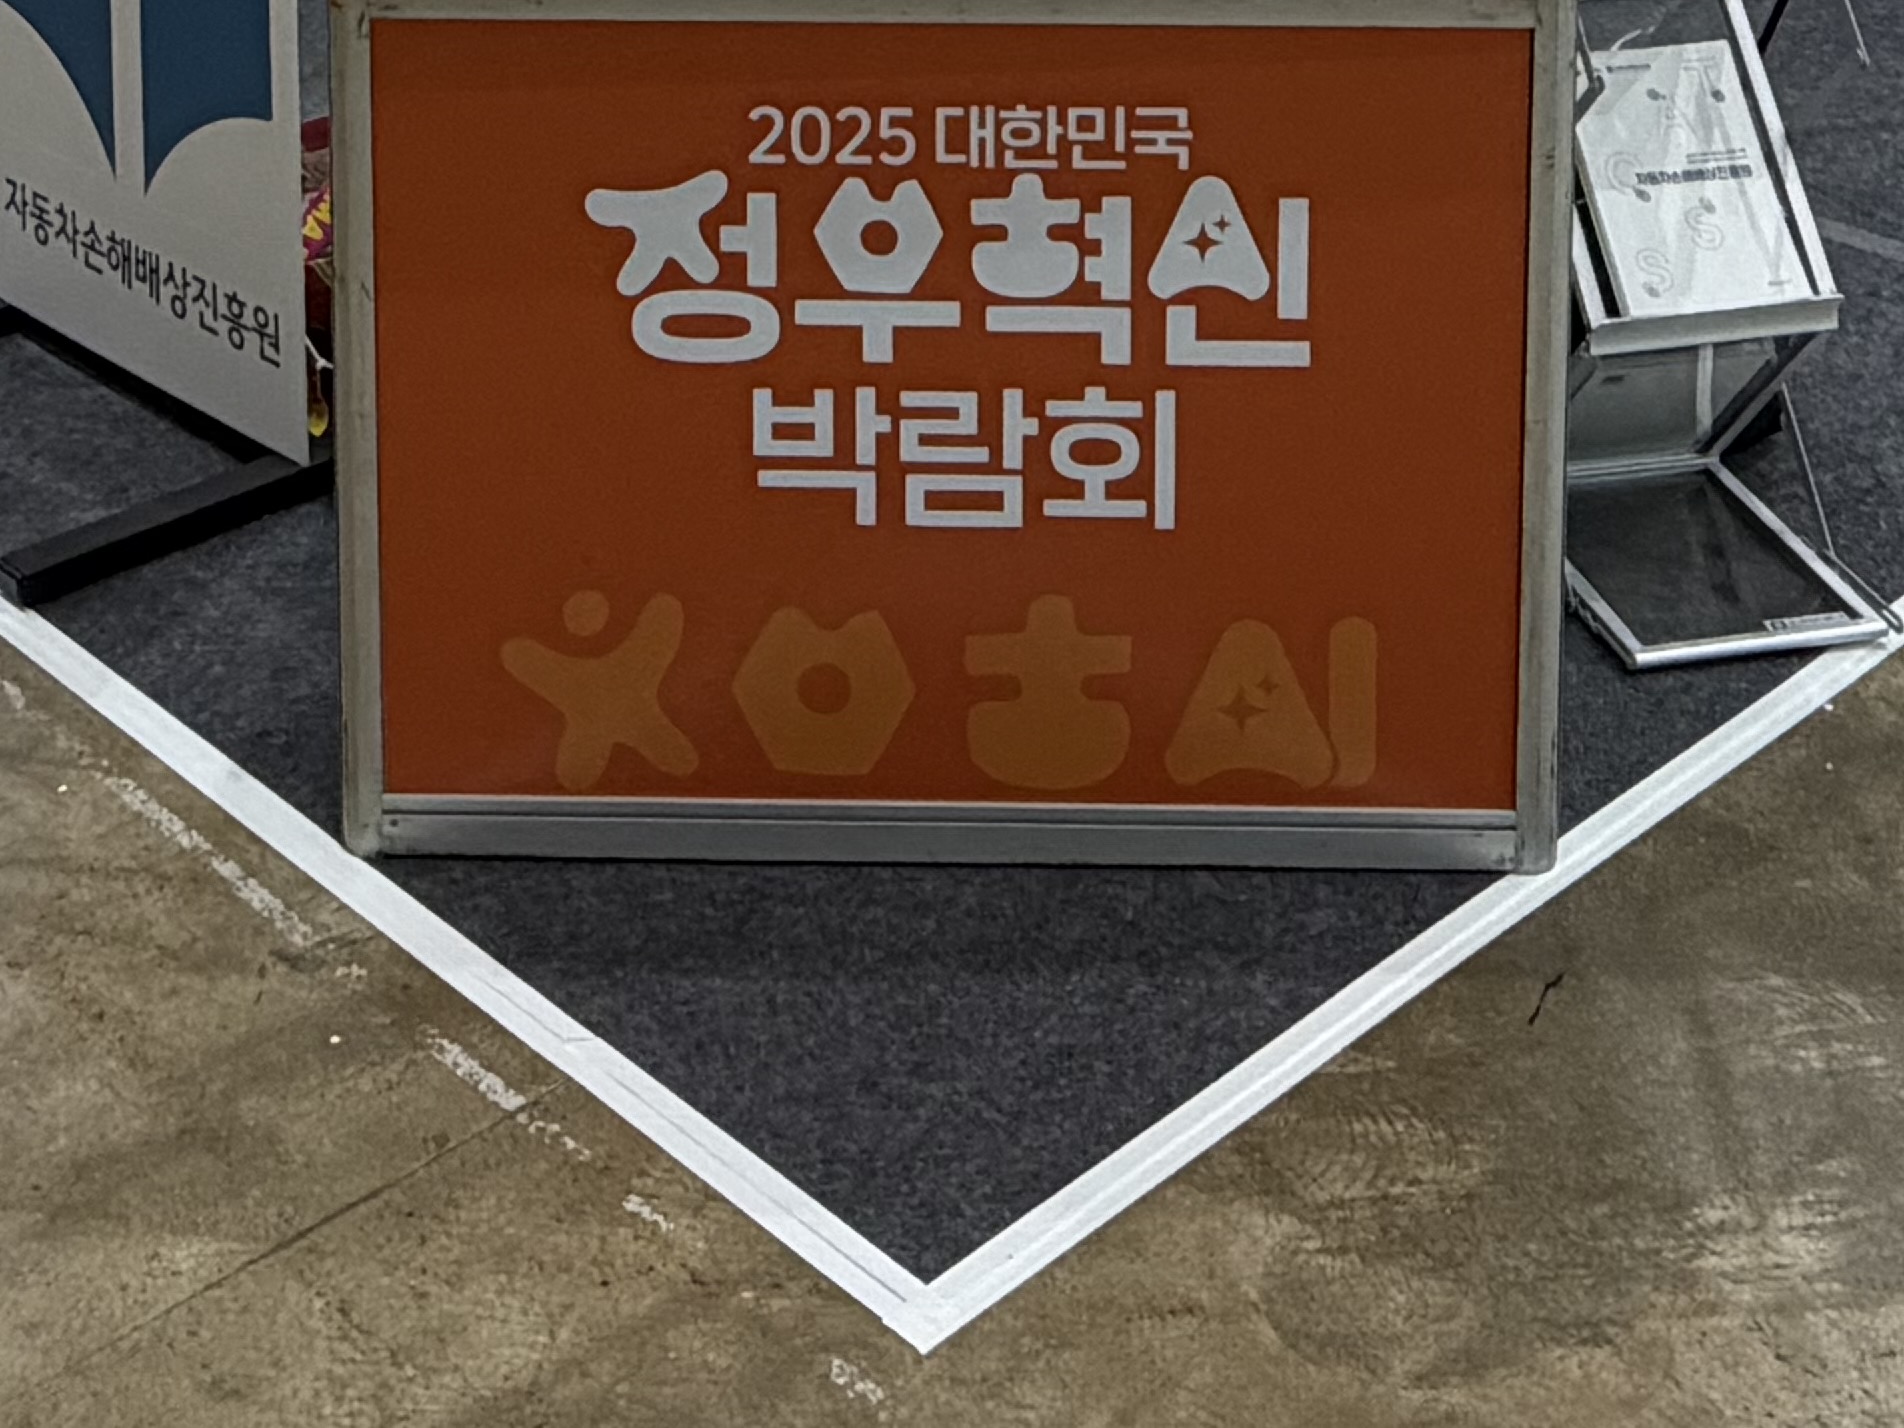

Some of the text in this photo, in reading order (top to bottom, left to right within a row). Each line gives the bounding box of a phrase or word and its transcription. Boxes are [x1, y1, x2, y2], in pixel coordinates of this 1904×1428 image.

[748, 104, 1194, 171] 2025 대한민국
[4, 176, 282, 368] 자동차손해배상진흥원
[752, 386, 1176, 530] 박람회
